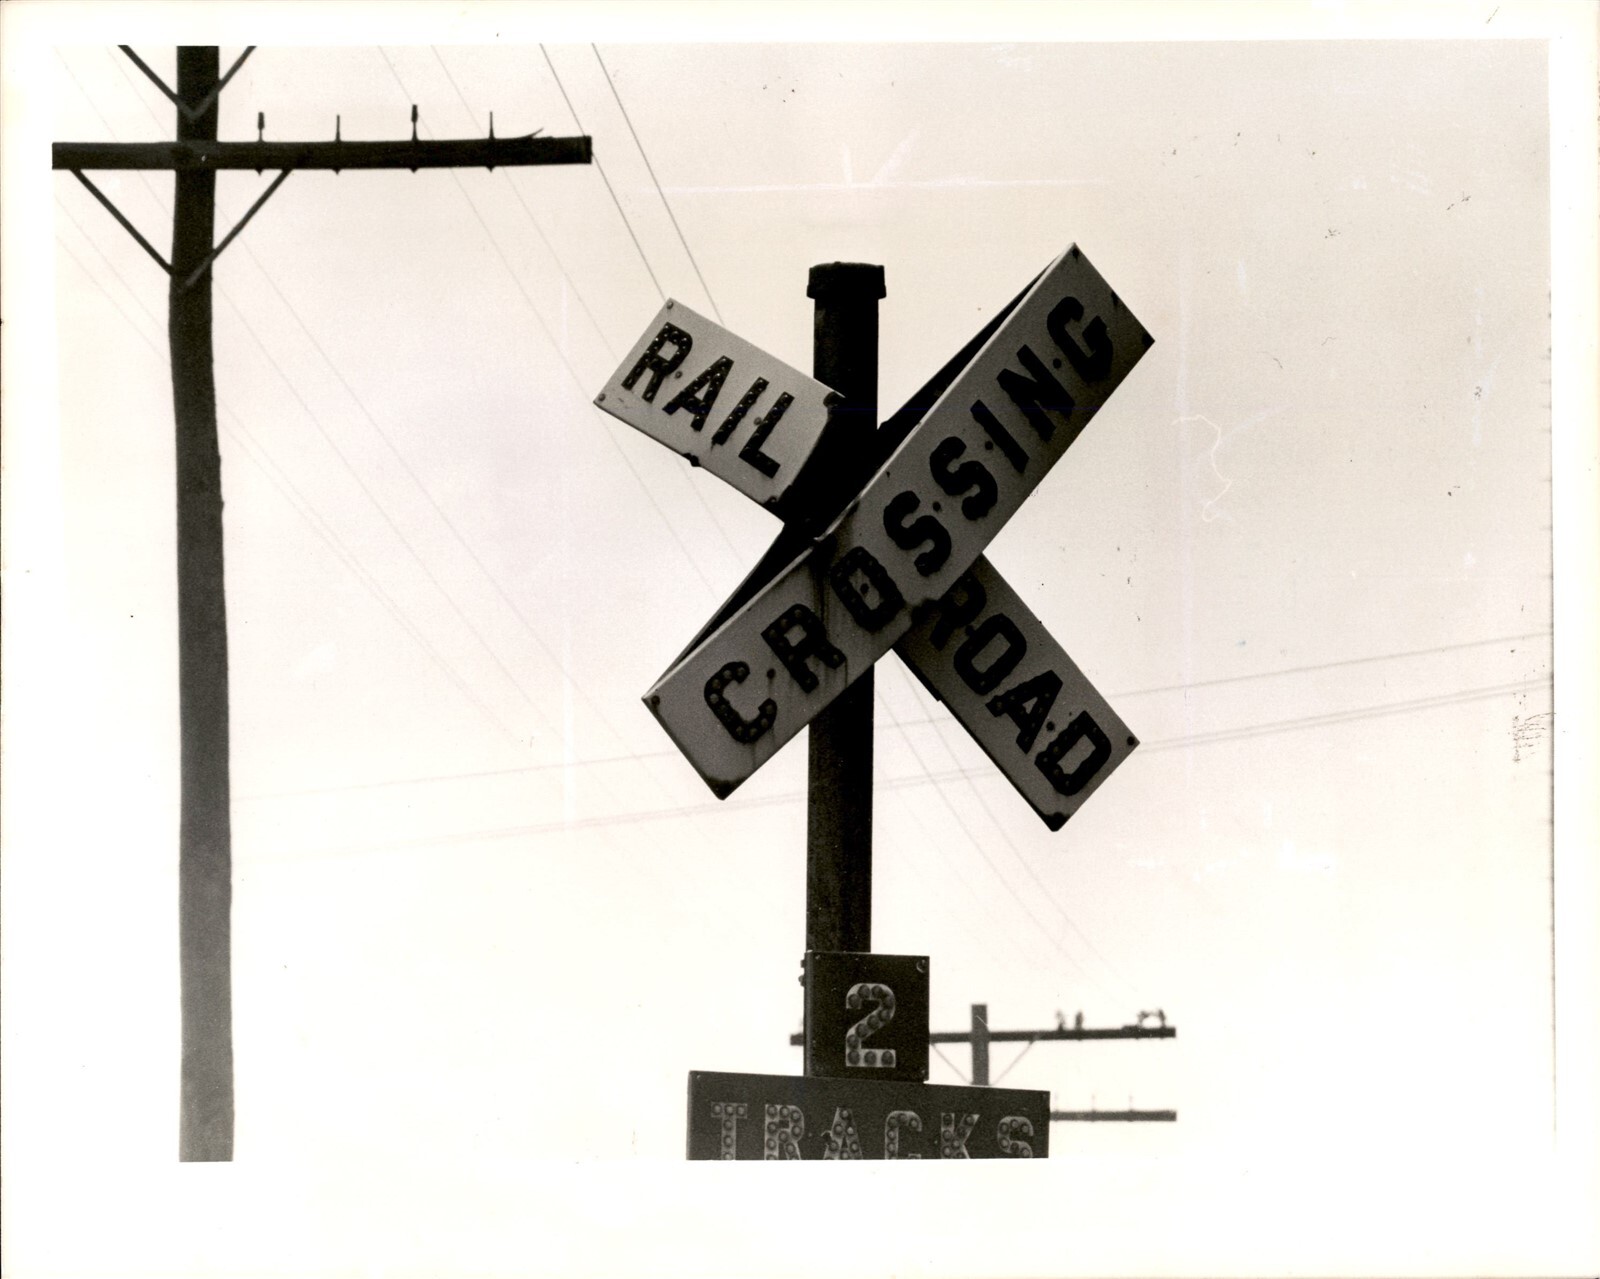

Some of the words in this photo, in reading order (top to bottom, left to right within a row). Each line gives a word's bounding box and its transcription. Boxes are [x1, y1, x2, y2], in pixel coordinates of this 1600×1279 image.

[621, 322, 795, 479] RAIL
[914, 572, 1112, 796] ROAD
[703, 296, 1113, 744] CROSSING
[711, 1103, 1034, 1160] TRACKS
[846, 983, 896, 1068] 2
